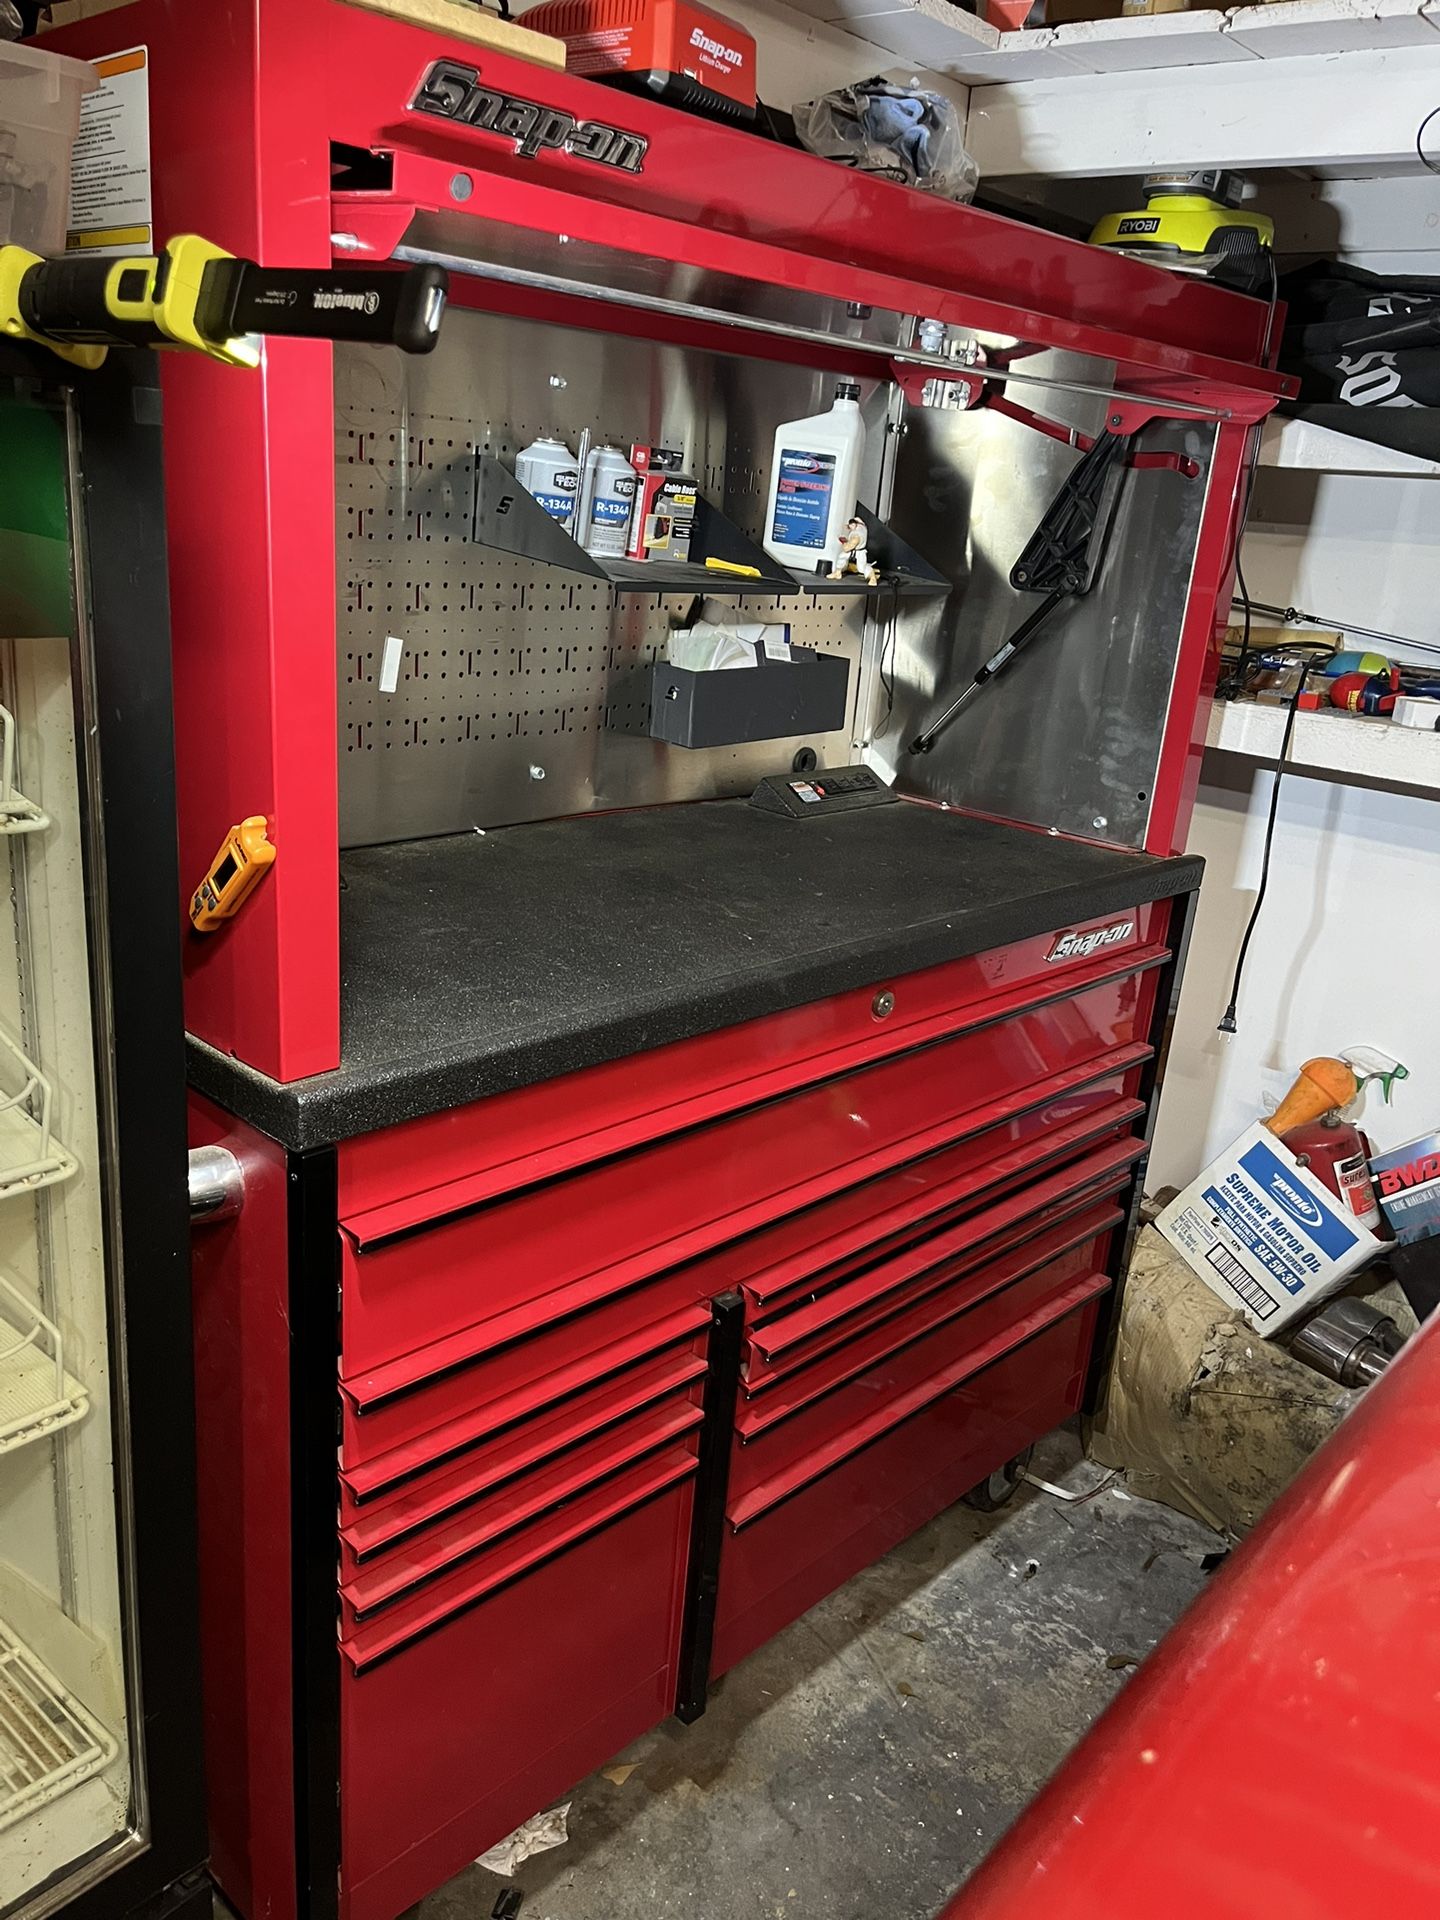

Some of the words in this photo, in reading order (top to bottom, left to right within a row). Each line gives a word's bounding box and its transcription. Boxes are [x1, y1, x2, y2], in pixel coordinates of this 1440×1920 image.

[689, 27, 743, 67] Snap-on
[408, 57, 647, 173] Snap-on
[1120, 219, 1157, 233] RYOBI
[596, 502, 629, 516] R-134A
[1049, 922, 1134, 962] Snap-on
[1379, 1152, 1440, 1196] BWD
[1225, 1206, 1237, 1219] FULL
[1233, 1200, 1248, 1214] PARA
[1244, 1211, 1262, 1230] MOTOR
[1271, 1177, 1313, 1214] pronto
[1225, 1172, 1272, 1220] SUPREME
[1266, 1216, 1305, 1255] MOTOR
[1300, 1252, 1322, 1274] OIL
[1253, 1243, 1275, 1263] SAE
[1268, 1259, 1298, 1287] 5W-30
